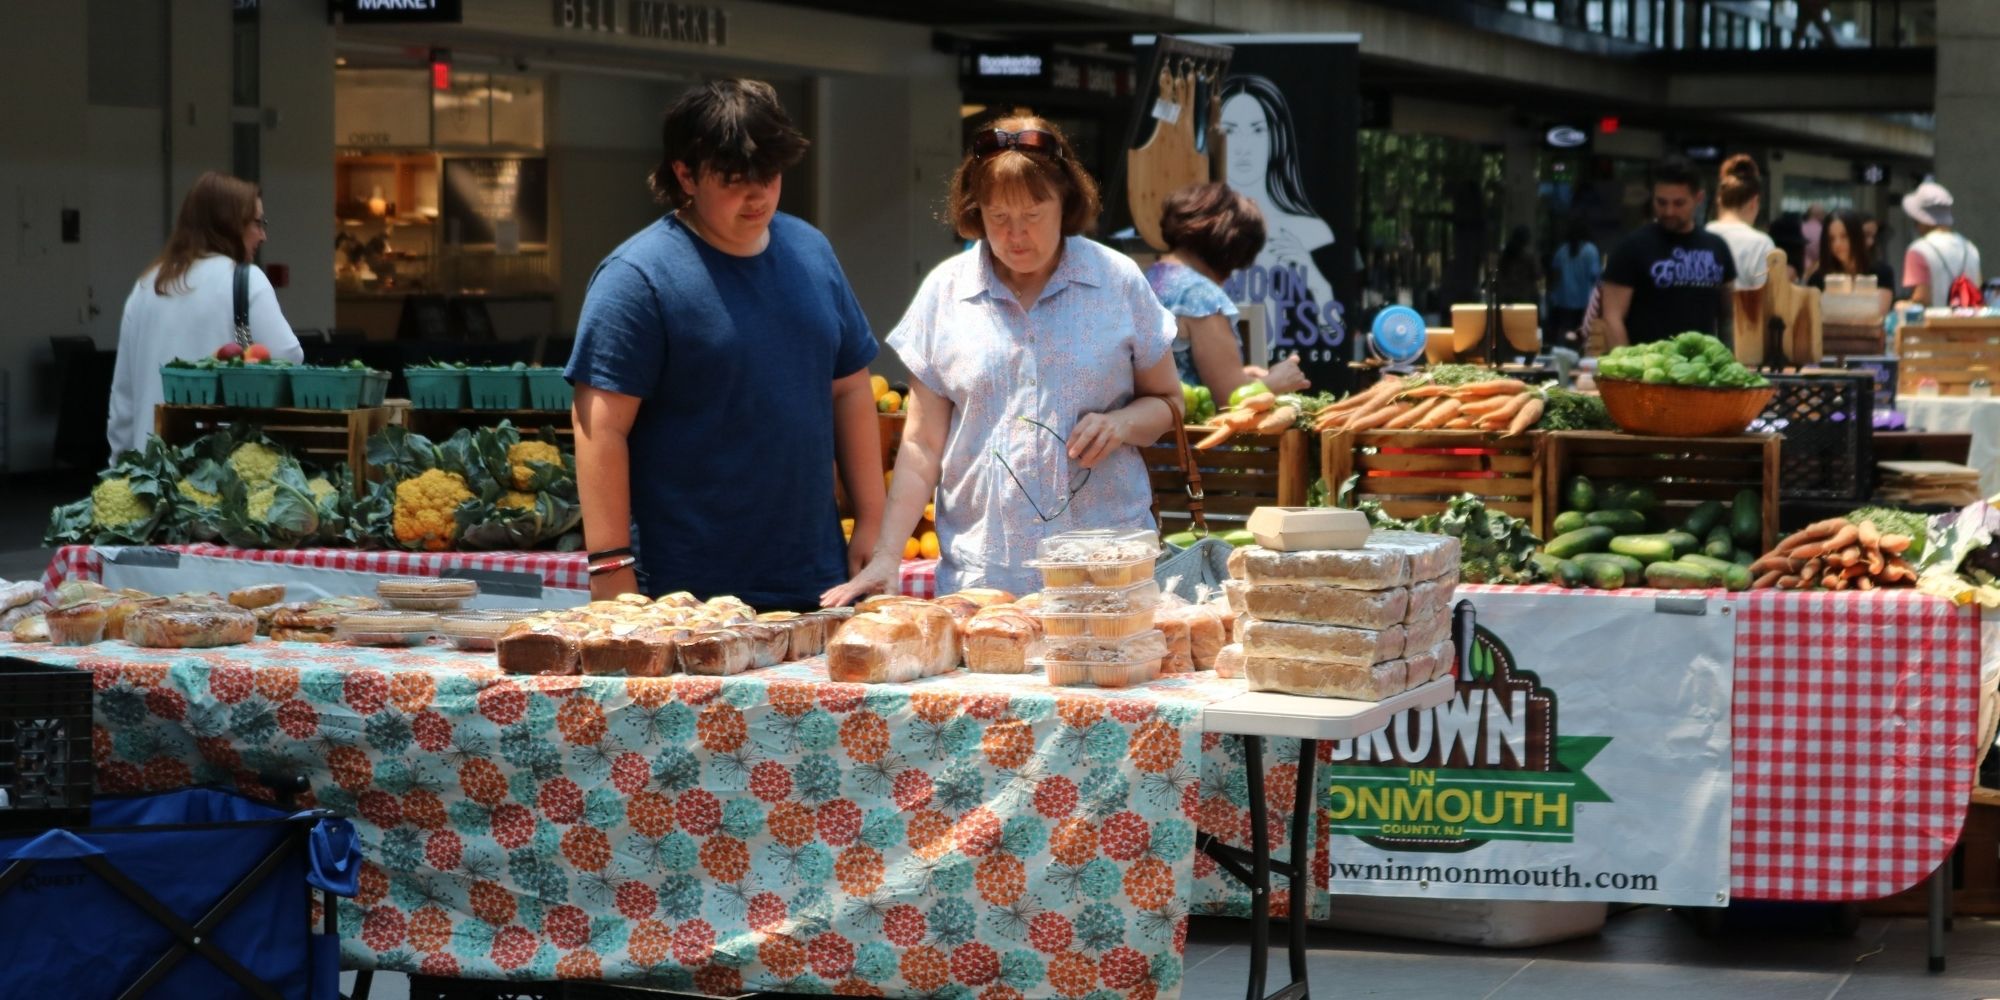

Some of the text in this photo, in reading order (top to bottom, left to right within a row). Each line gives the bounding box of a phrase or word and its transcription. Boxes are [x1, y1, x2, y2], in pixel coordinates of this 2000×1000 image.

[562, 0, 734, 46] BELL MARKET
[1267, 300, 1345, 347] ESS
[1409, 769, 1436, 787] IN
[1329, 785, 1568, 827] ONMOUTH
[1444, 825, 1464, 836] NJ
